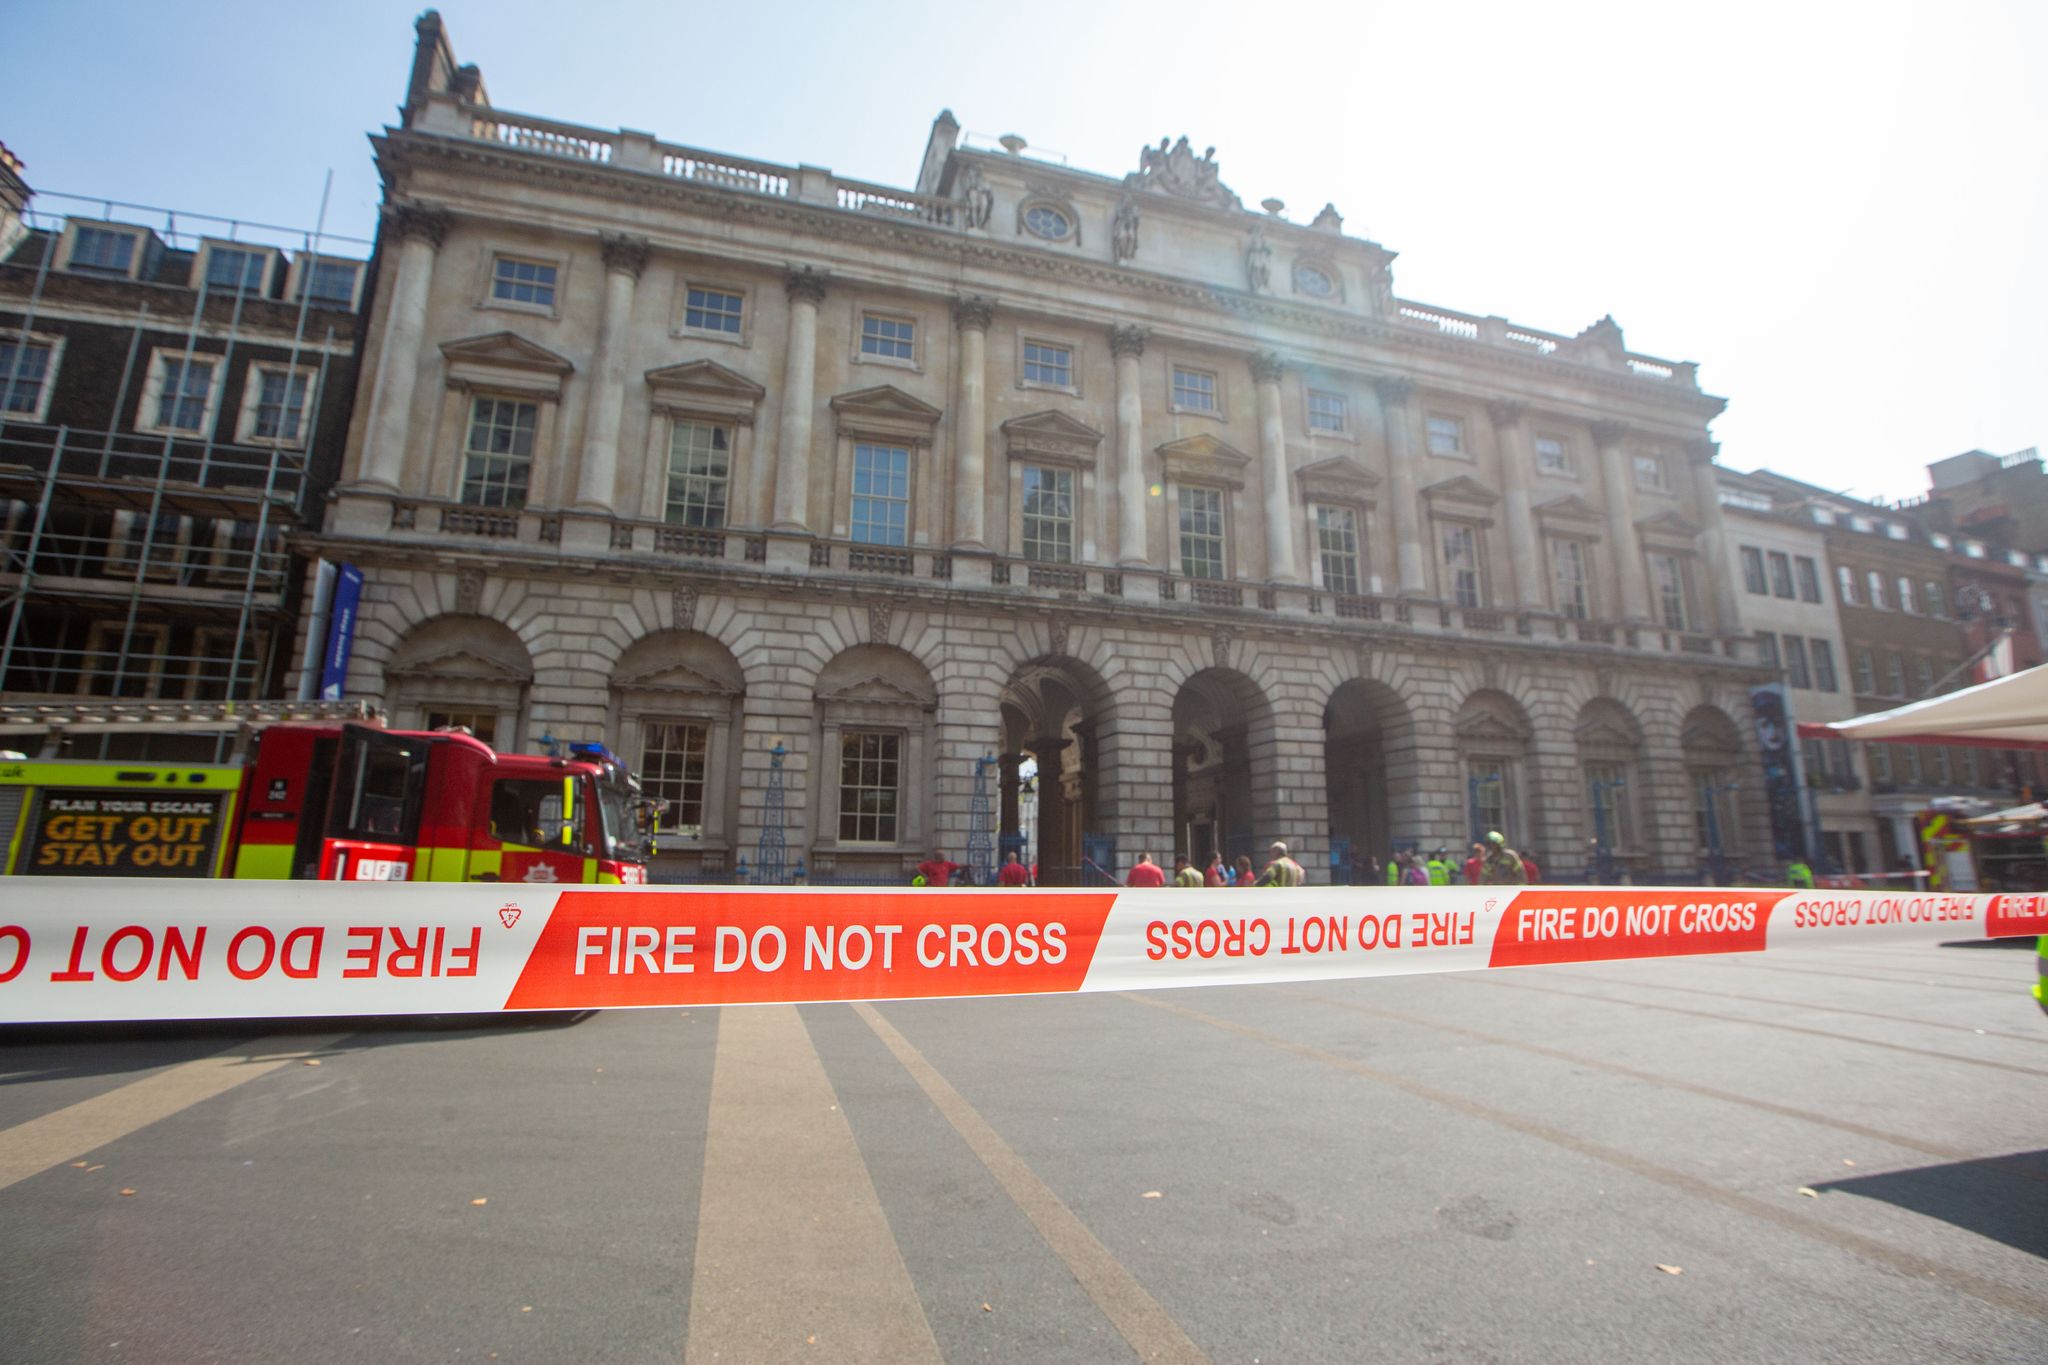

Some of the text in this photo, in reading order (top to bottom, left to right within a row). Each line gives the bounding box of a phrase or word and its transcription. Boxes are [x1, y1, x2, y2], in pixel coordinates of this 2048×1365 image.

[49, 798, 213, 814] PLAN YOUR ESCAPE
[46, 815, 211, 842] GET OUT
[37, 843, 205, 867] STAY OUT
[1517, 902, 1757, 942] FIRE DO NOT CROSS
[1794, 896, 1977, 928] FIRE DO NOT CROSS
[1997, 896, 2034, 919] FIRE
[50, 925, 207, 982] NOT
[226, 925, 325, 980] DO
[342, 926, 482, 978] FIRE
[574, 922, 1067, 975] FIRE DO NOT CROSS
[1146, 911, 1475, 961] FIRE DO NOT CROSS
